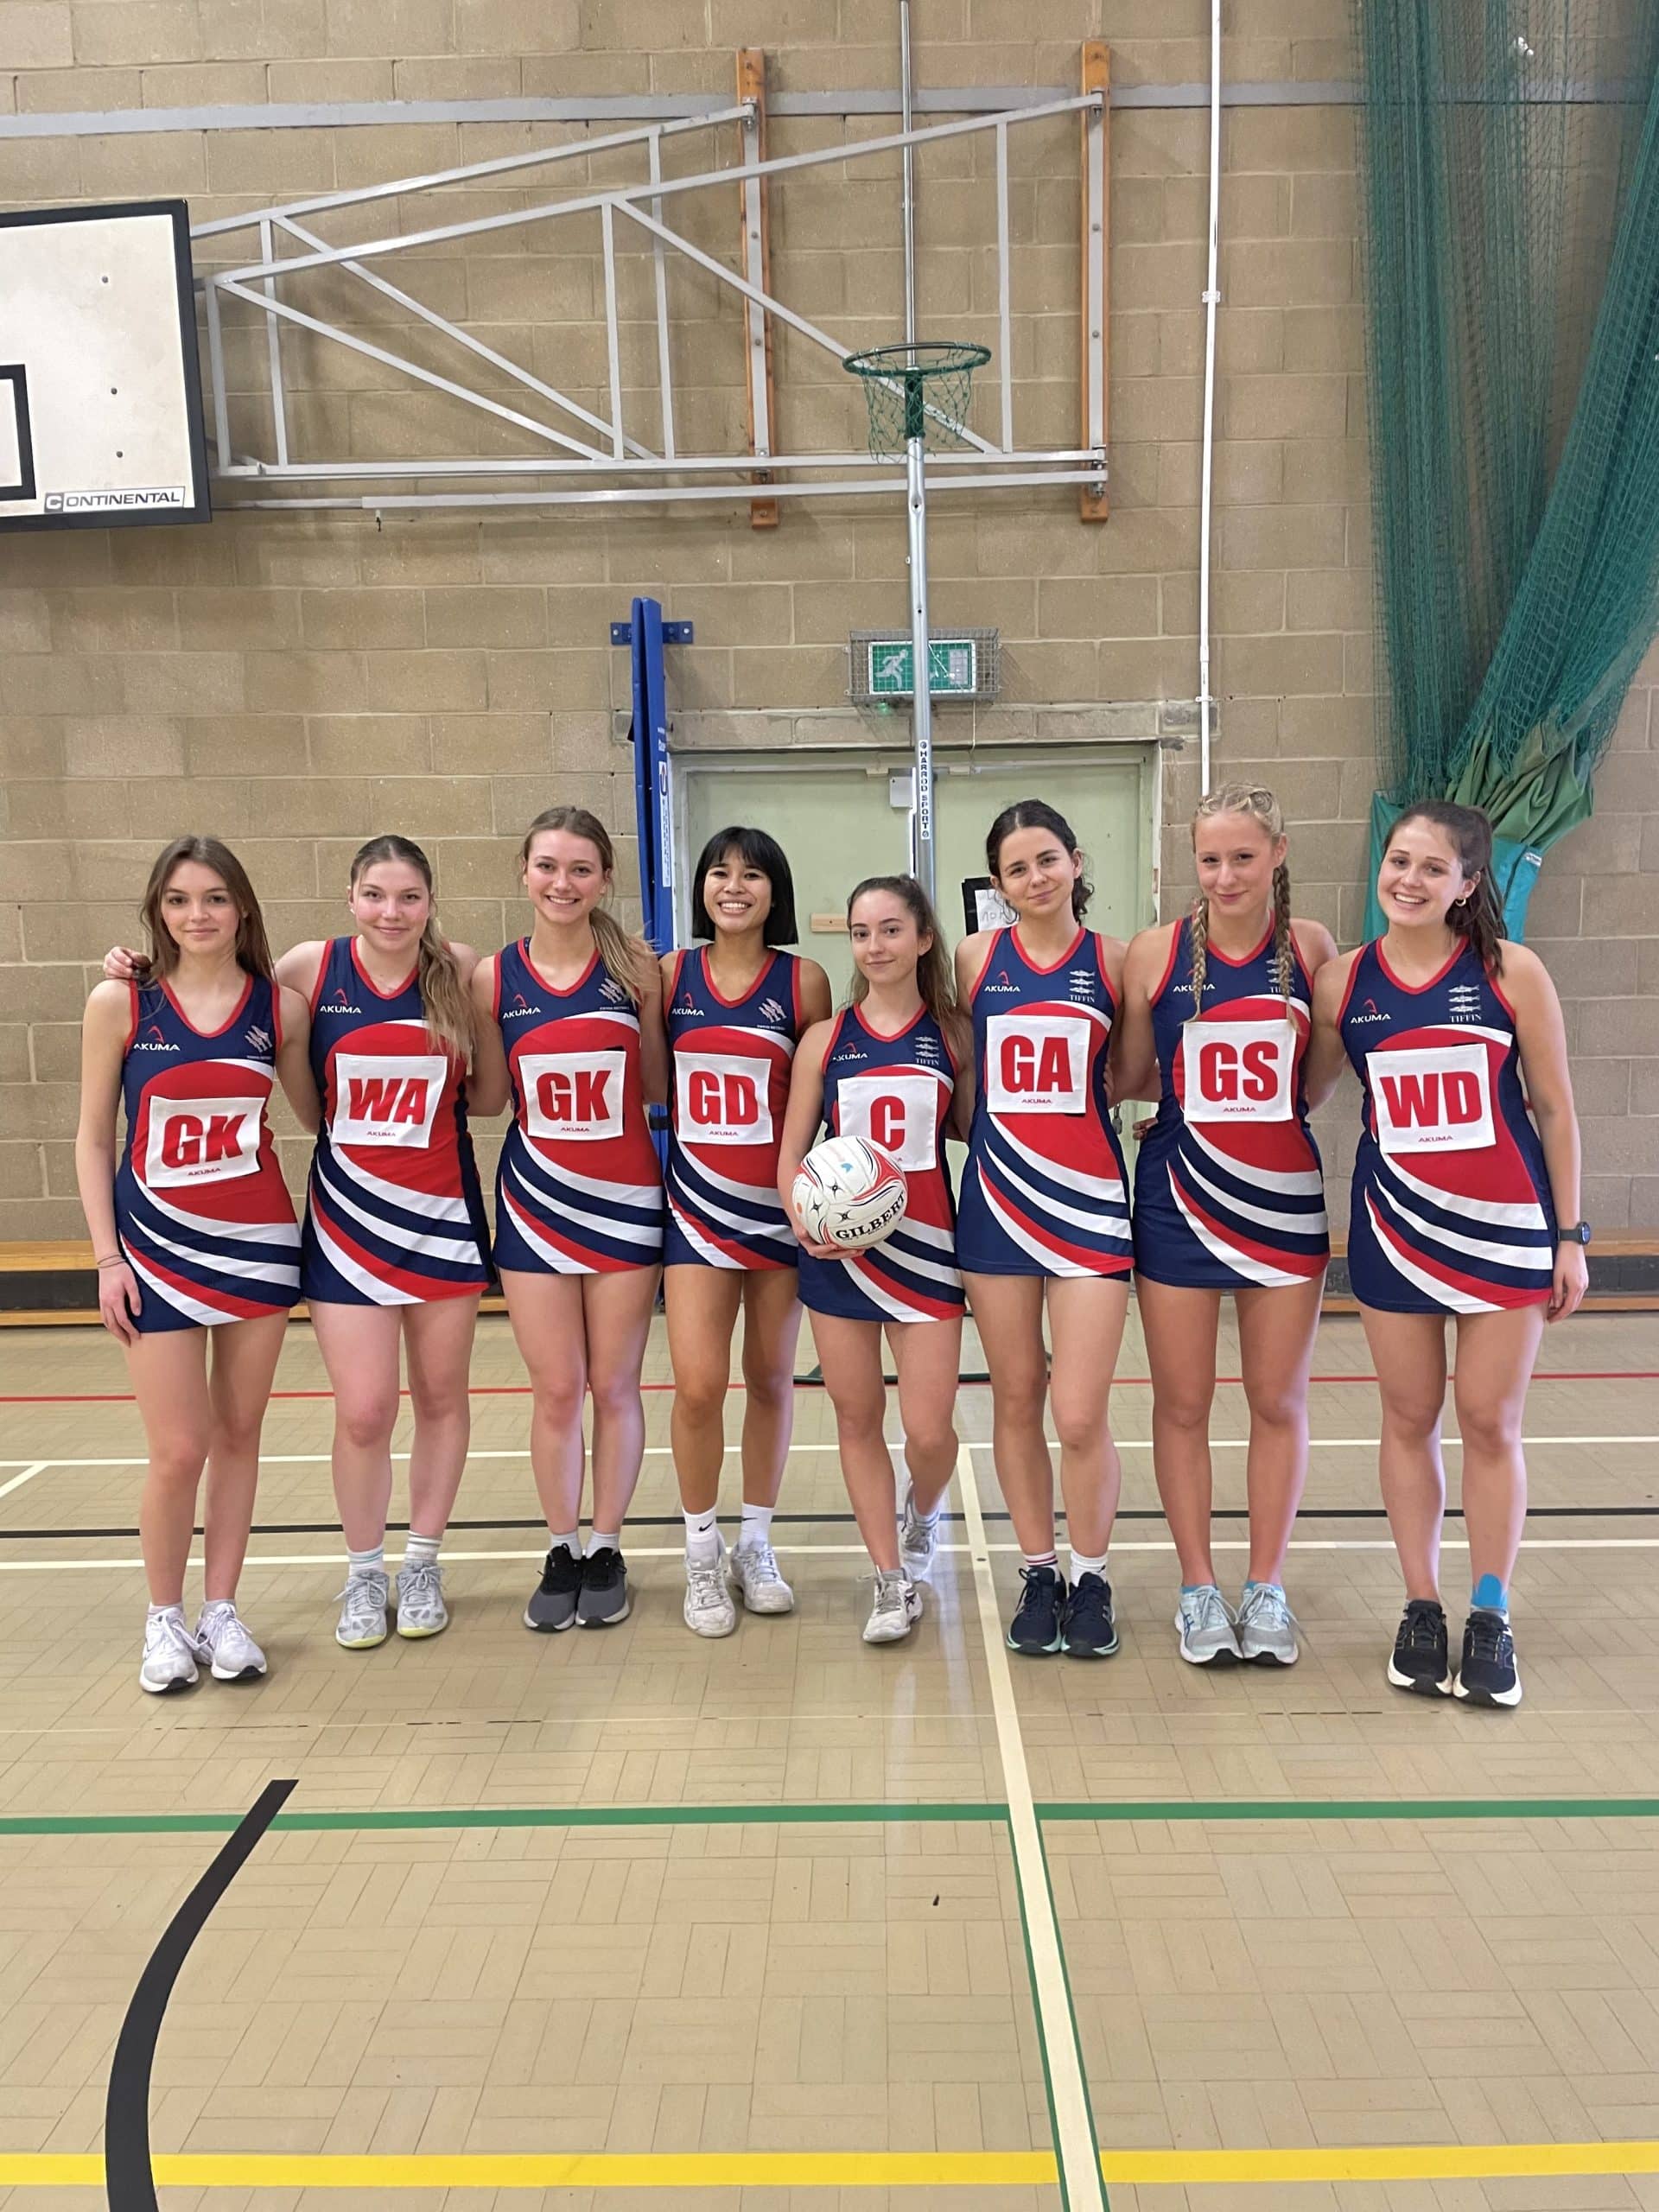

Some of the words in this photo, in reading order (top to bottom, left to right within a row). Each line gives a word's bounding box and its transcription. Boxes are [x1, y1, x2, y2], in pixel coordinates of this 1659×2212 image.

[46, 491, 180, 511] CONTINENTAL
[320, 1005, 361, 1014] AKUMA
[503, 1007, 541, 1020] AKUMA
[671, 1007, 705, 1017] AKUMA
[1070, 995, 1096, 1003] TIFFIN
[1351, 1013, 1391, 1024] AKUMA
[1449, 1014, 1482, 1023] TIFFIN
[133, 1043, 181, 1052] AKUMA
[1001, 1035, 1073, 1093] GA
[1199, 1041, 1279, 1102] GS
[348, 1078, 429, 1125] WA
[537, 1071, 611, 1122] GK
[689, 1071, 759, 1125] GD
[1379, 1071, 1483, 1128] WD
[870, 1096, 906, 1152] C
[162, 1114, 248, 1168] GK
[188, 1167, 221, 1177] AKUMA
[836, 1192, 905, 1239] GILBERT
